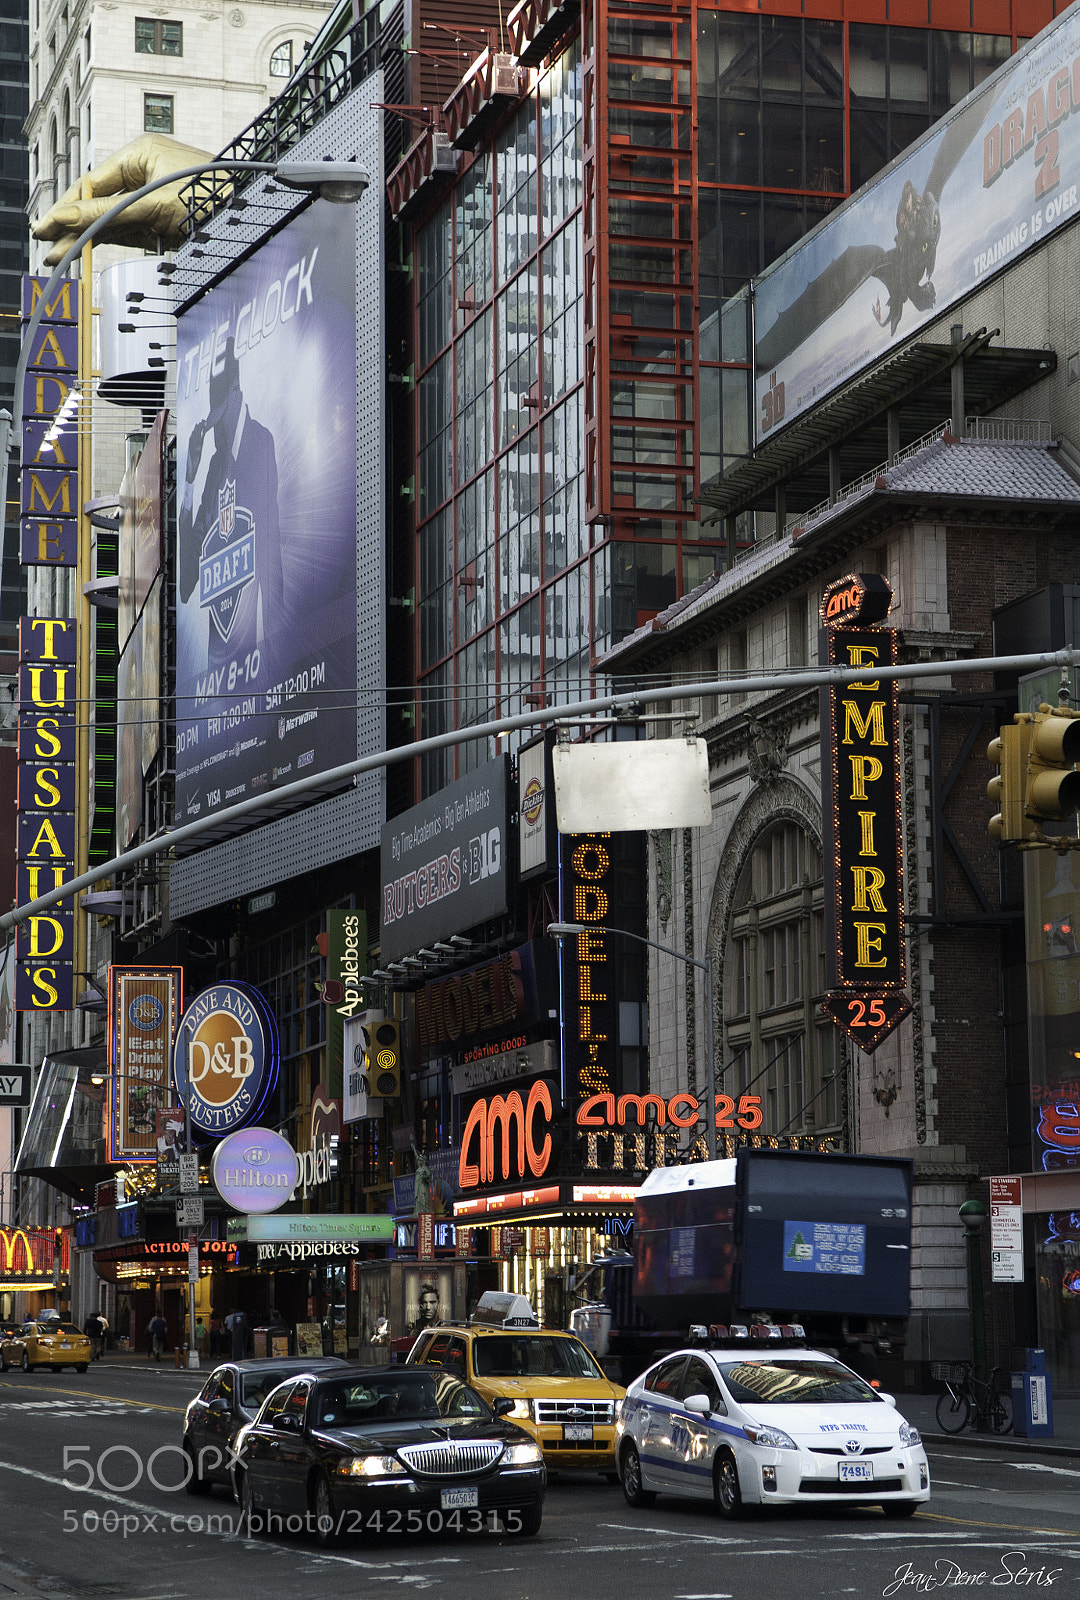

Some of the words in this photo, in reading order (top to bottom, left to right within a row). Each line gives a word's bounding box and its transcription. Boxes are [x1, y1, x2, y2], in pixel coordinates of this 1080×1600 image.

[1034, 128, 1061, 203] 2
[973, 222, 1028, 277] TRAINING
[1031, 209, 1043, 235] IS
[185, 319, 230, 400] THE
[233, 246, 319, 360] CLOCK
[769, 370, 777, 390] IN
[26, 278, 76, 562] MADAME
[761, 381, 786, 434] 3D
[220, 505, 234, 534] NFL
[202, 542, 251, 595] DRAFT
[220, 601, 233, 612] 2014
[194, 666, 225, 708] MAY
[227, 649, 260, 691] 8-10
[186, 724, 199, 749] PM
[207, 715, 221, 738] FRI
[222, 704, 241, 736] 7:00
[242, 696, 256, 725] PM
[265, 681, 282, 711] SAT
[284, 670, 309, 702] 12:00
[310, 661, 326, 689] PM
[206, 788, 221, 808] VISA
[251, 772, 268, 788] GMC
[277, 762, 292, 776] Microsoft
[25, 618, 69, 1008] TUSSAUD'S
[523, 793, 544, 811] Dickies
[841, 644, 890, 969] EMPIRE
[392, 836, 401, 862] Big
[400, 831, 415, 855] Time
[414, 814, 442, 846] Academics
[444, 805, 455, 832] Big
[454, 800, 465, 822] Ten
[464, 786, 490, 819] Athletics
[384, 847, 461, 925] RUTGERS
[462, 855, 468, 875] is
[336, 914, 364, 1018] Applebee's
[133, 1007, 160, 1019] D&B
[184, 991, 219, 1033] DAVE
[221, 991, 254, 1027] AND
[847, 999, 887, 1028] 25
[128, 1036, 164, 1050] Eat
[128, 1051, 164, 1064] Drink
[188, 1035, 255, 1083] D&B
[464, 1042, 500, 1063] SPORTING
[501, 1035, 527, 1052] GOODS
[128, 1065, 164, 1082] Play
[349, 1071, 366, 1097] Hilto
[189, 1088, 252, 1127] BUSTER'S
[714, 1094, 763, 1130] 25
[183, 1155, 194, 1163] BUS
[223, 1168, 289, 1189] Hilton
[992, 1207, 999, 1216] 3
[288, 1222, 318, 1233] Hilton
[319, 1222, 348, 1233] Times
[348, 1222, 381, 1235] Square
[424, 1214, 432, 1254] MODELL'S
[832, 1224, 849, 1234] PARK
[850, 1225, 864, 1235] AVE
[993, 1253, 999, 1261] 5
[513, 1317, 530, 1327] 3N27
[819, 1424, 840, 1432] NYPD
[840, 1423, 869, 1432] TRAFFIC
